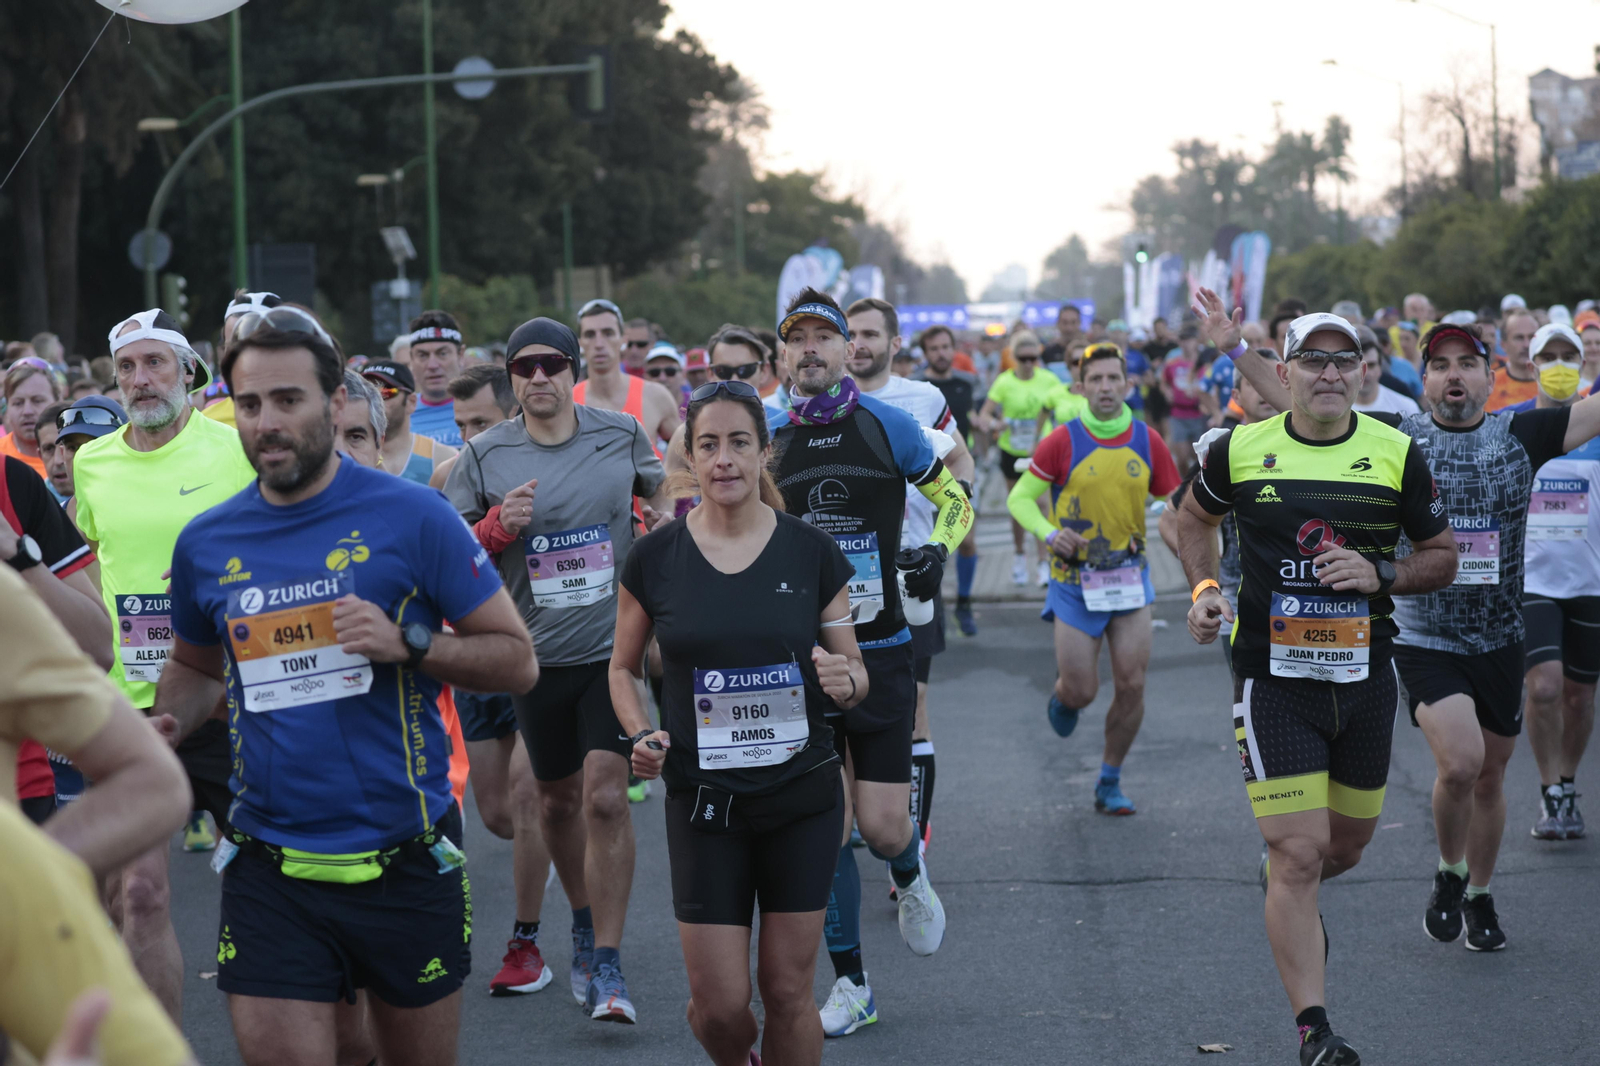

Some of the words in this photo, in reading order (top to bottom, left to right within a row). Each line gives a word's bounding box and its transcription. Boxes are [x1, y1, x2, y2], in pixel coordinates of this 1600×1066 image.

[808, 434, 842, 447] land
[1543, 482, 1582, 491] ZURICH
[552, 530, 599, 548] ZURICH
[836, 538, 870, 551] RICH
[556, 558, 586, 572] 6390
[1280, 559, 1331, 579] are
[1462, 561, 1495, 570] CIDONC
[218, 572, 252, 586] VIATOR
[562, 577, 586, 589] SAMI
[268, 578, 338, 606] ZURICH
[1303, 602, 1357, 614] ZURICH
[274, 622, 314, 646] 4941
[1303, 629, 1336, 642] 4255
[1286, 649, 1314, 660] JUAN
[1318, 651, 1354, 662] PEDRO
[280, 654, 318, 673] TONY
[728, 670, 790, 687] ZURICH
[732, 704, 769, 720] 9160
[732, 728, 775, 742] RAMOS
[1269, 790, 1304, 800] BENITO
